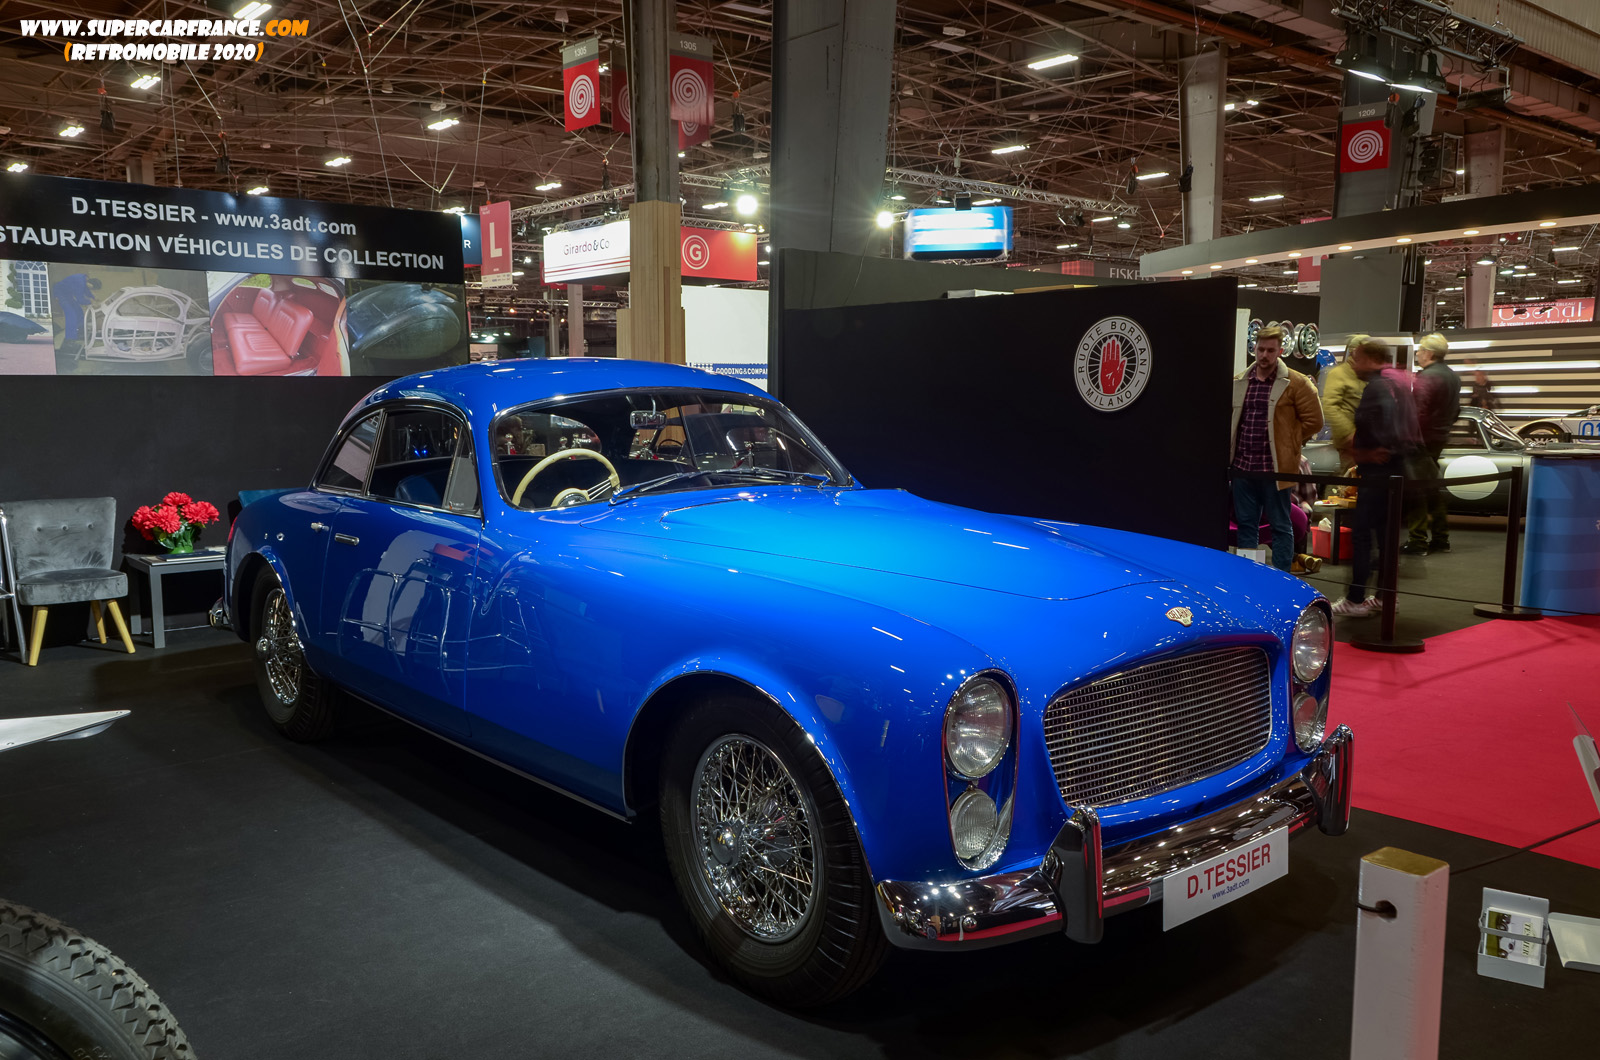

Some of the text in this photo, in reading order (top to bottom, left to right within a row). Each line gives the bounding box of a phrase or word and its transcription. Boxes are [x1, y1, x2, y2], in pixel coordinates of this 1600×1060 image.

[574, 46, 587, 57] 1305
[679, 40, 697, 51] 1305
[1358, 109, 1376, 117] 1209
[71, 196, 197, 223] D.TESSIER
[214, 212, 357, 235] www.3adt.com
[489, 222, 503, 258] L
[157, 233, 283, 260] VÉHICULES
[290, 245, 318, 262] DE
[323, 247, 444, 270] COLLECTION
[689, 244, 702, 261] G
[1078, 321, 1147, 375] RUOTE BORRANI
[1085, 388, 1132, 407] MILANO
[1187, 843, 1271, 899] D.TESSIER
[1212, 878, 1250, 900] www.3adt.com
